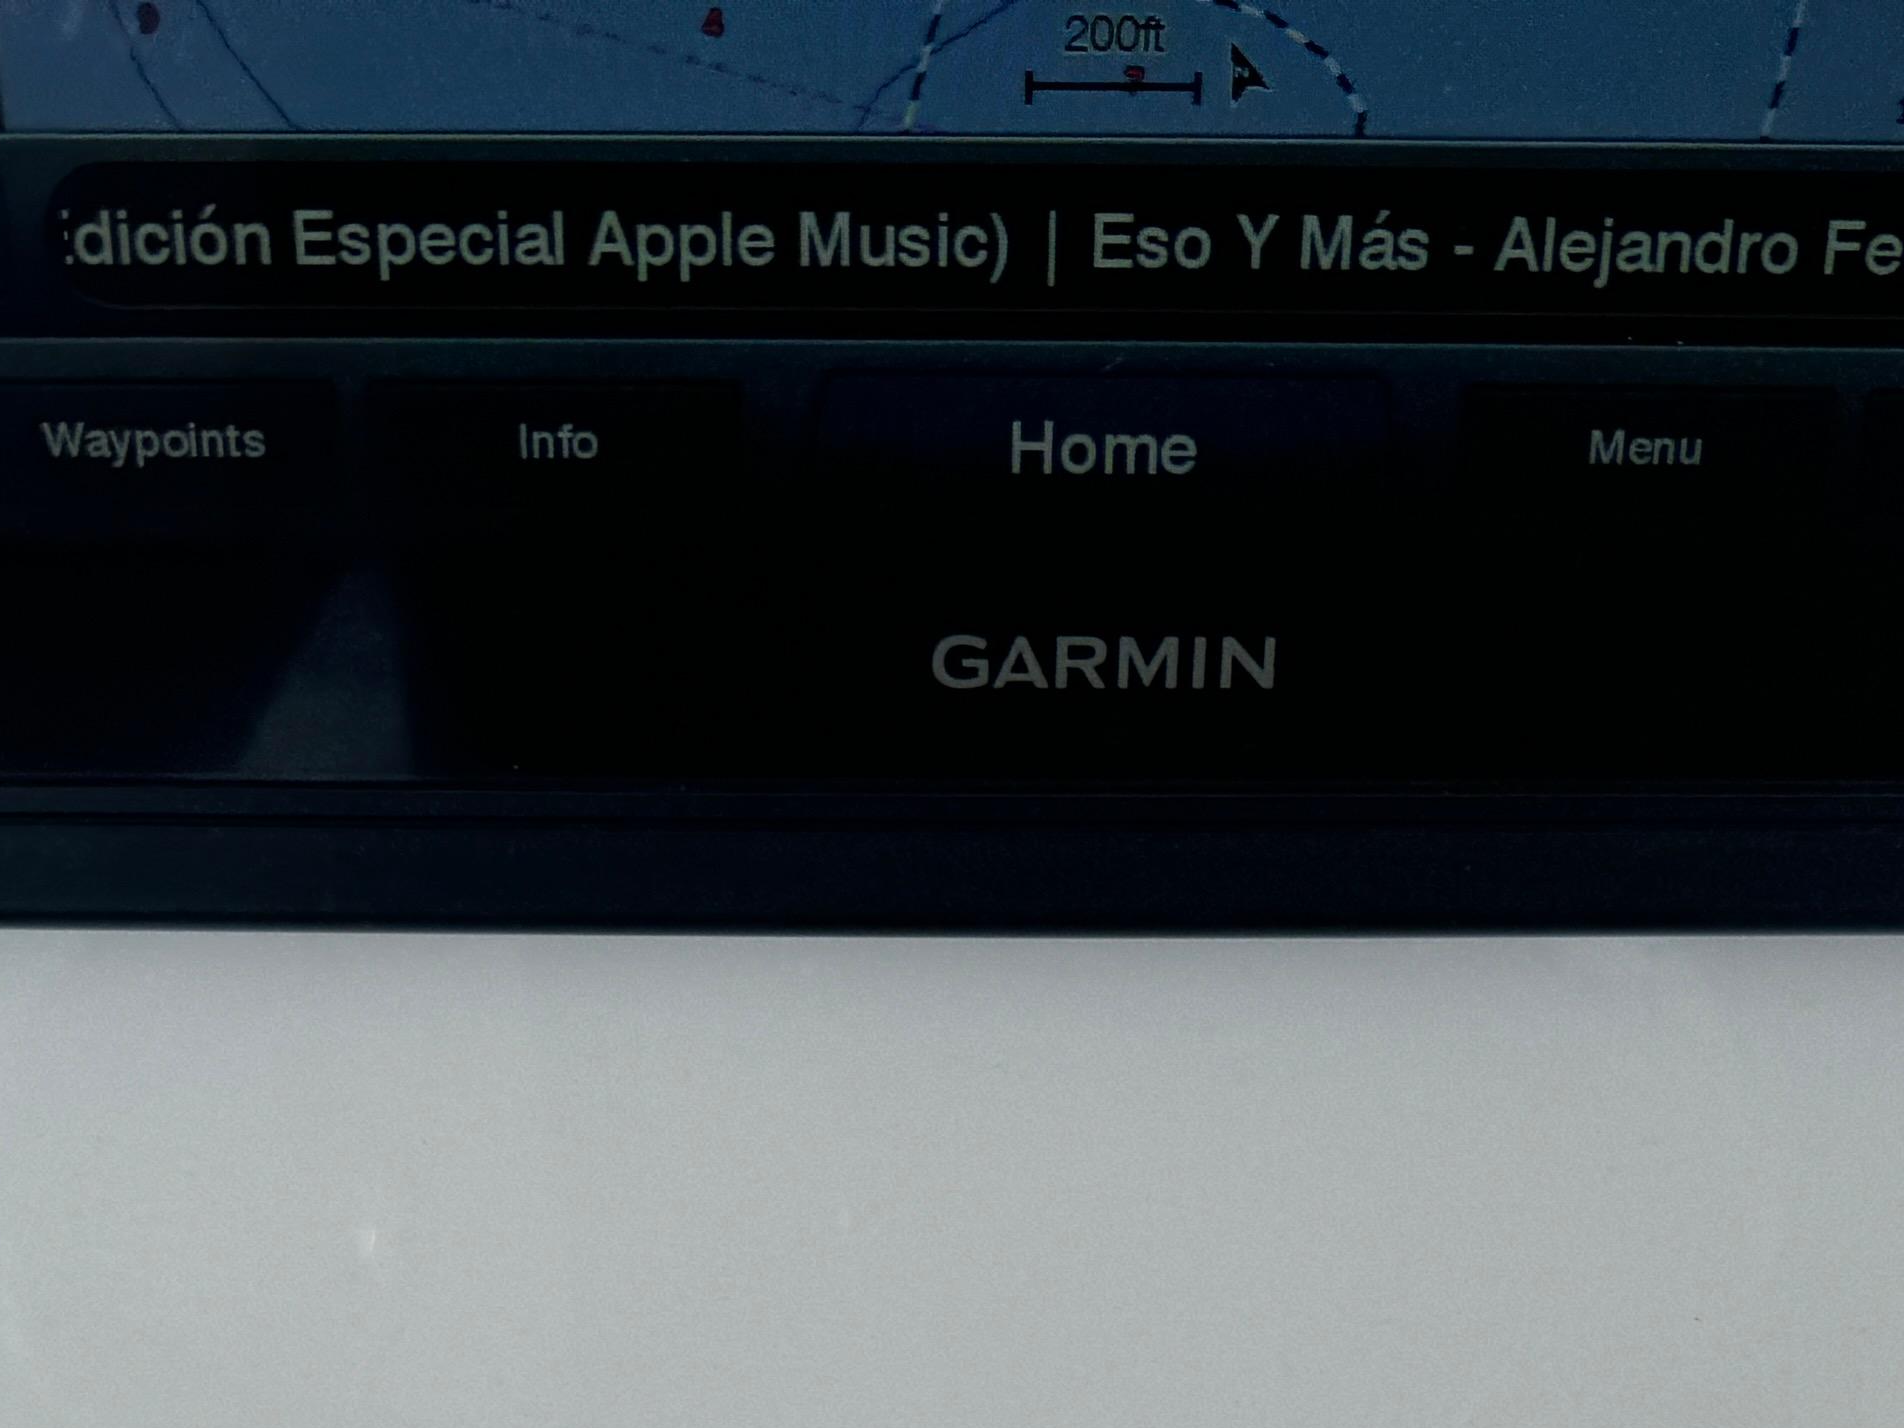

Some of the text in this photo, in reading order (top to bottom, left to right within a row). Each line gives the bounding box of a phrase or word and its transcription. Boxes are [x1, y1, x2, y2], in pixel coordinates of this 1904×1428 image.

[1064, 14, 1167, 55] 200ft
[60, 203, 273, 267] dición
[293, 209, 566, 283] Especial
[588, 210, 776, 284] Apple
[799, 210, 1010, 285] Music)
[1093, 212, 1213, 270] Eso
[1236, 213, 1280, 270] Y
[1299, 209, 1431, 271] Más
[1494, 215, 1800, 290] Alejandro
[40, 421, 267, 468] Waypoints
[519, 423, 600, 460] Info
[1010, 420, 1199, 475] Home
[1588, 428, 1704, 466] Menu
[930, 634, 1279, 690] GARMIN
